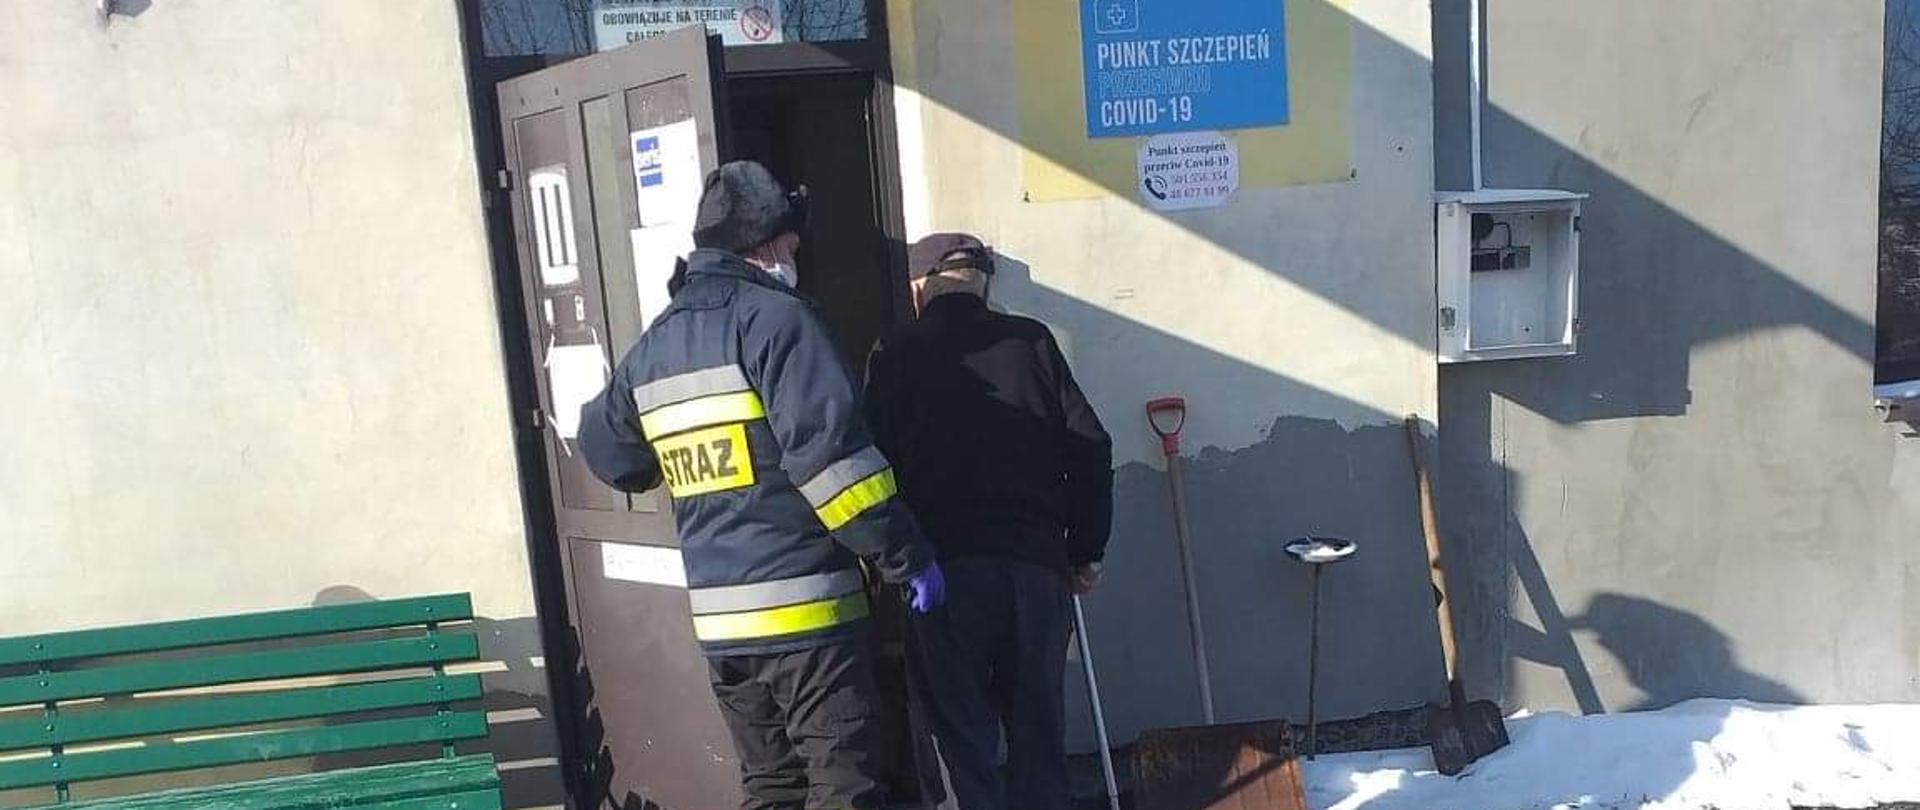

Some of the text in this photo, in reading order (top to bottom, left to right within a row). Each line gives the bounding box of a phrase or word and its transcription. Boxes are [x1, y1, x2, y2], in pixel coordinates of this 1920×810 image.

[602, 8, 738, 27] OBOWIĄZUJE NA TERENIE
[1098, 28, 1270, 69] PUNKT SZCZEPIEŃ
[1101, 95, 1192, 127] COVID-19
[1148, 144, 1178, 157] Punkt
[1144, 155, 1230, 176] przeciw Covid-19
